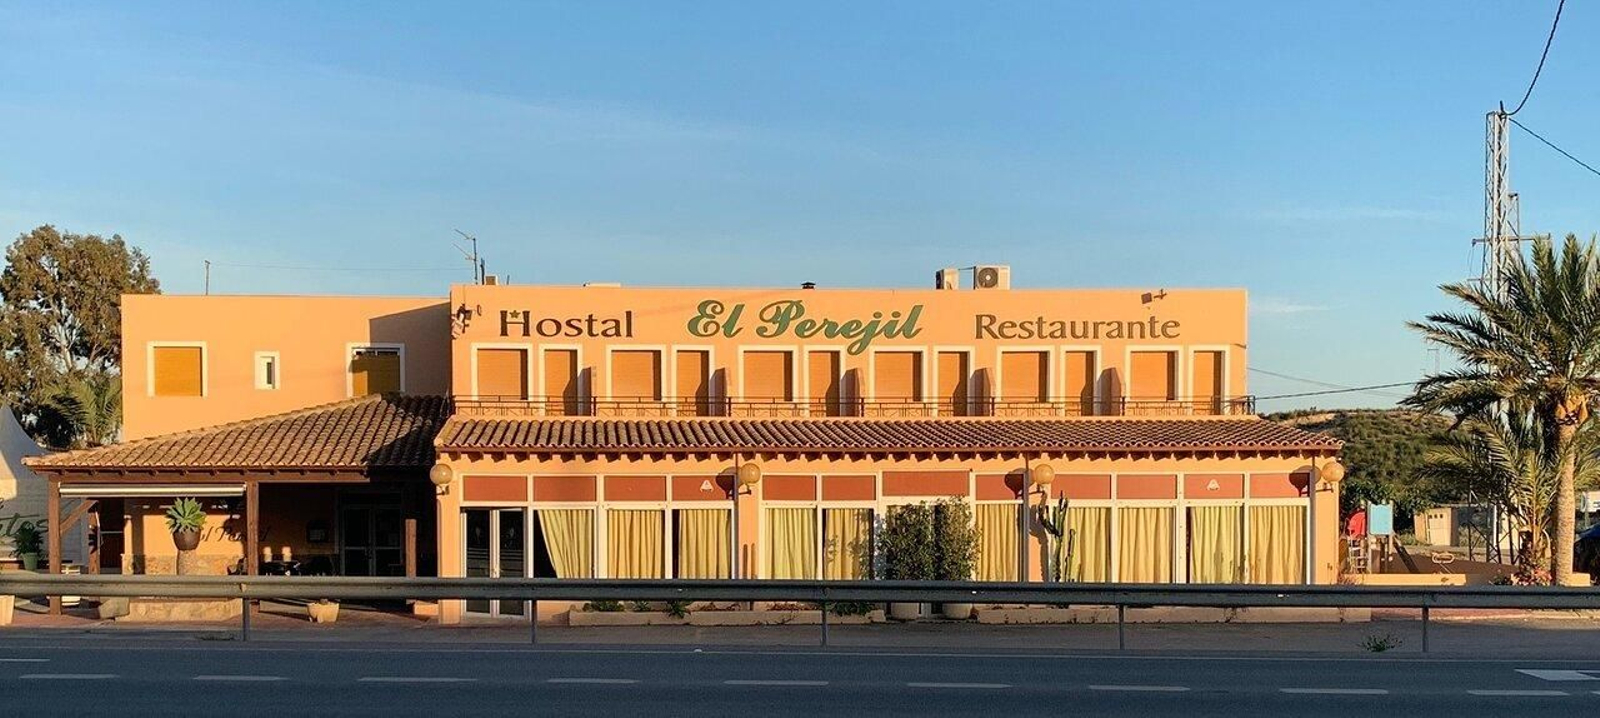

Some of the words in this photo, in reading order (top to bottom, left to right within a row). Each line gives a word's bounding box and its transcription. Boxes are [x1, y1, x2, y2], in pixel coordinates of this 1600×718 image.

[499, 309, 634, 338] Hostal
[687, 299, 746, 339] El
[755, 299, 924, 356] Perejil
[974, 313, 1181, 340] Restaurante
